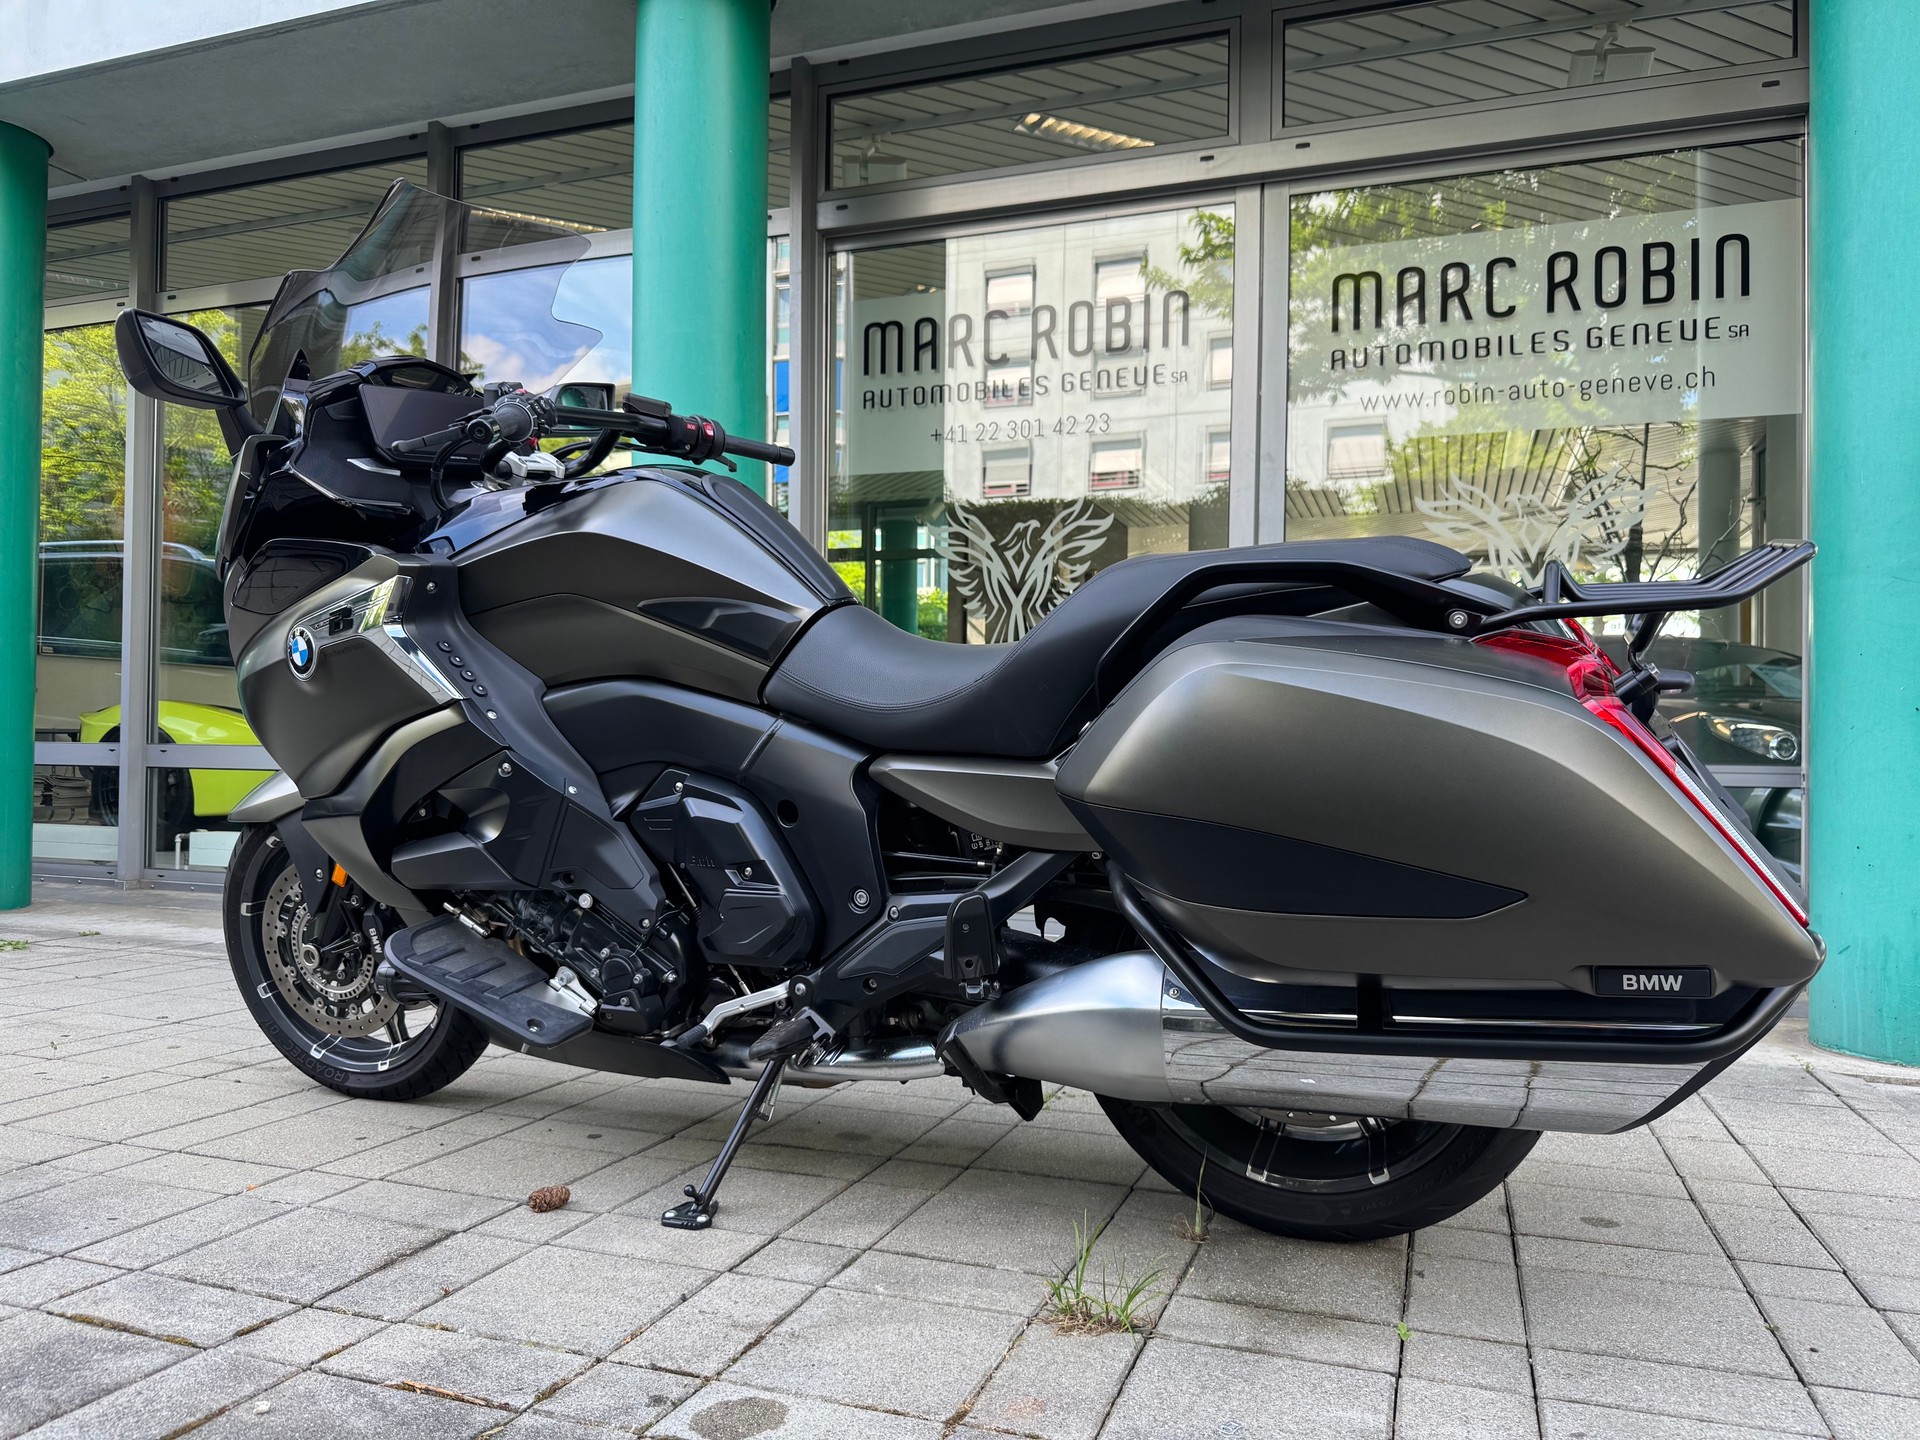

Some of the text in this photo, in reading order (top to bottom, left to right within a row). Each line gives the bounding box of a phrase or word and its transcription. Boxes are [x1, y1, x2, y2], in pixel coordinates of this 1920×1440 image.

[1331, 232, 1751, 333] MARC ROBIN
[863, 290, 1190, 377] MARC ROBIN
[1330, 329, 1570, 370] AUTOMOBILES
[1728, 323, 1750, 339] SA
[862, 374, 1050, 410] AUTOMOBILES
[1171, 370, 1188, 384] SA
[1360, 366, 1716, 412] www.robin-auto-geneve.ch
[930, 412, 1111, 443] +41 22 301 42 23
[369, 927, 383, 954] BMW
[1622, 974, 1683, 992] BMW
[284, 1041, 346, 1083] ROADTEC
